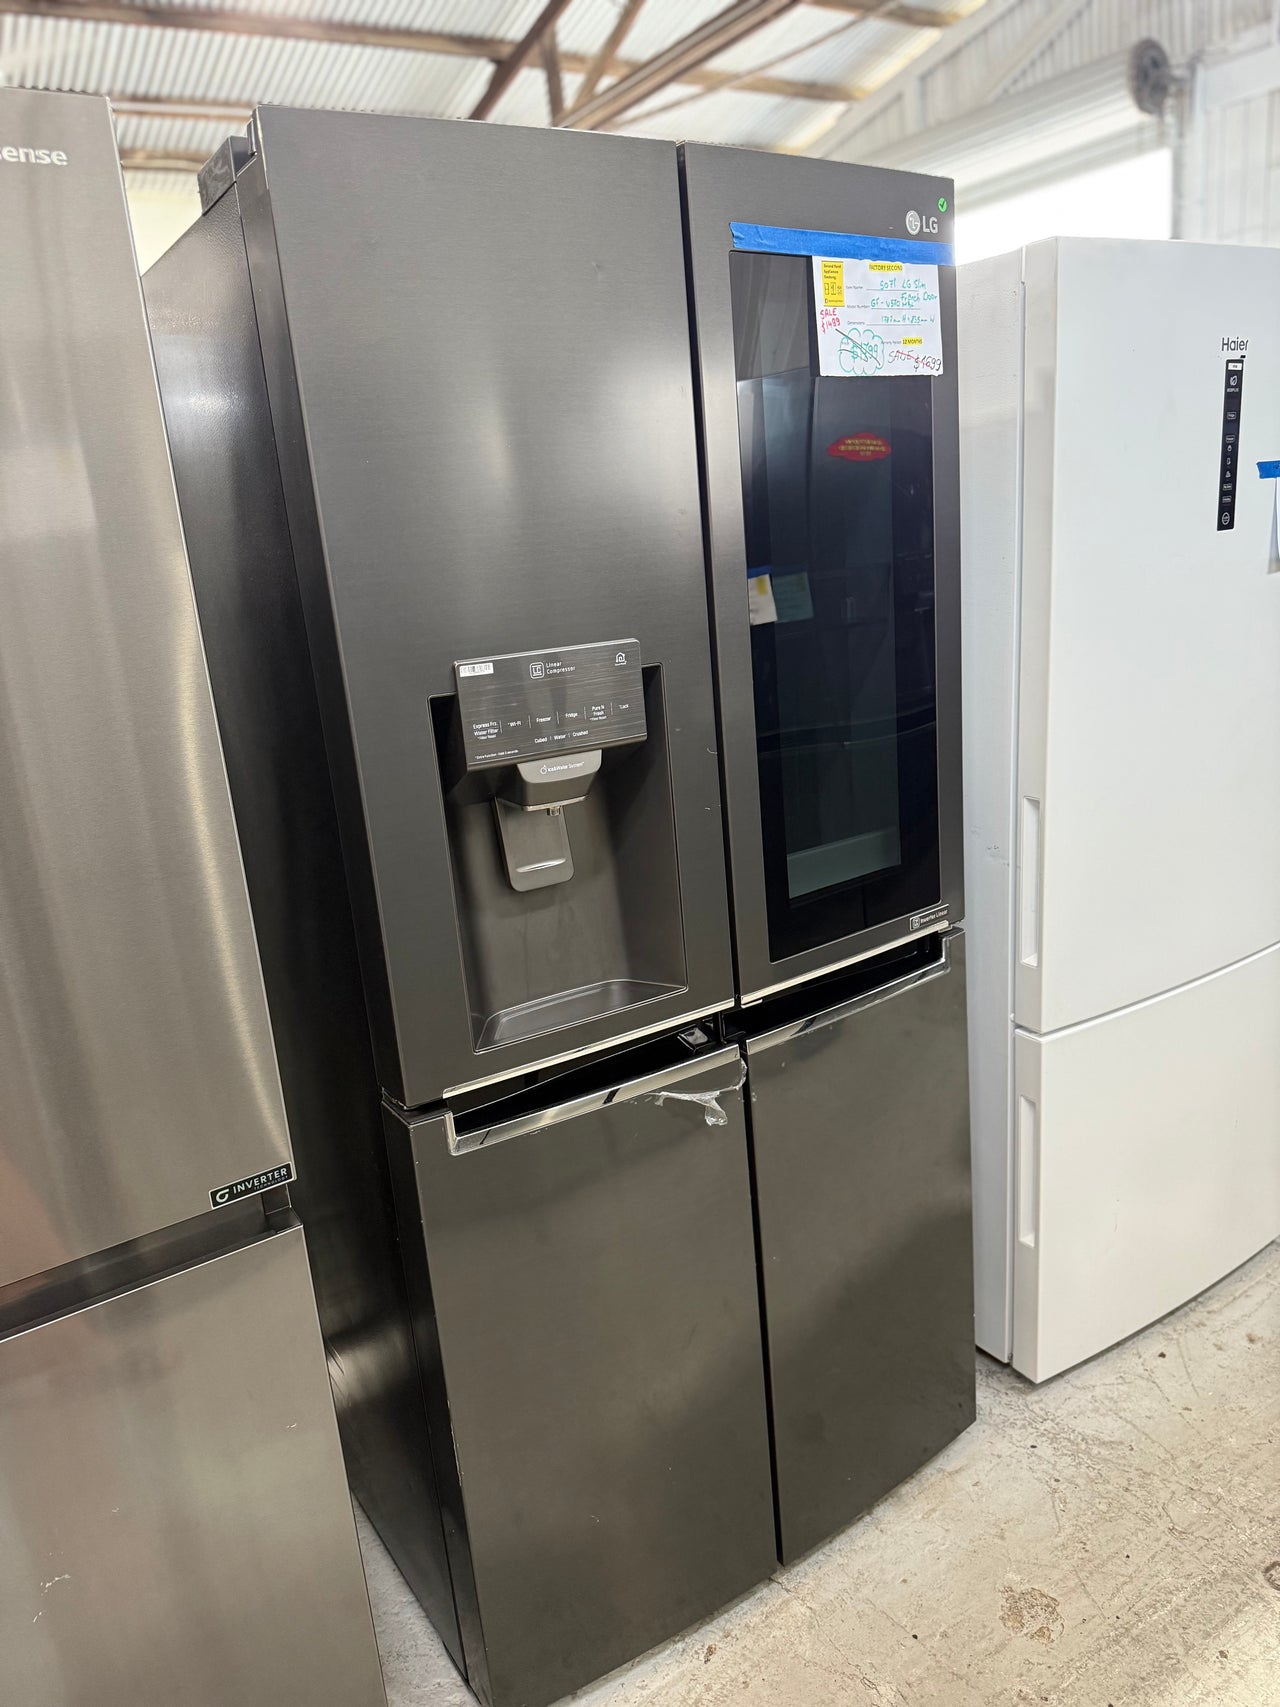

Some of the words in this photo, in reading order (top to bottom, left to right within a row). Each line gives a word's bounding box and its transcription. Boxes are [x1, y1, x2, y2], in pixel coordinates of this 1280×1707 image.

[0, 146, 68, 166] ense
[922, 215, 939, 234] LG
[902, 279, 911, 289] LG
[901, 292, 920, 302] French
[923, 291, 938, 301] Door
[820, 308, 837, 320] SALE
[821, 317, 841, 334] $1499
[1221, 337, 1249, 352] Haier
[914, 354, 942, 372] $1699
[546, 665, 576, 675] Compressor
[936, 909, 948, 917] Linear
[233, 1168, 287, 1193] INVERTER
